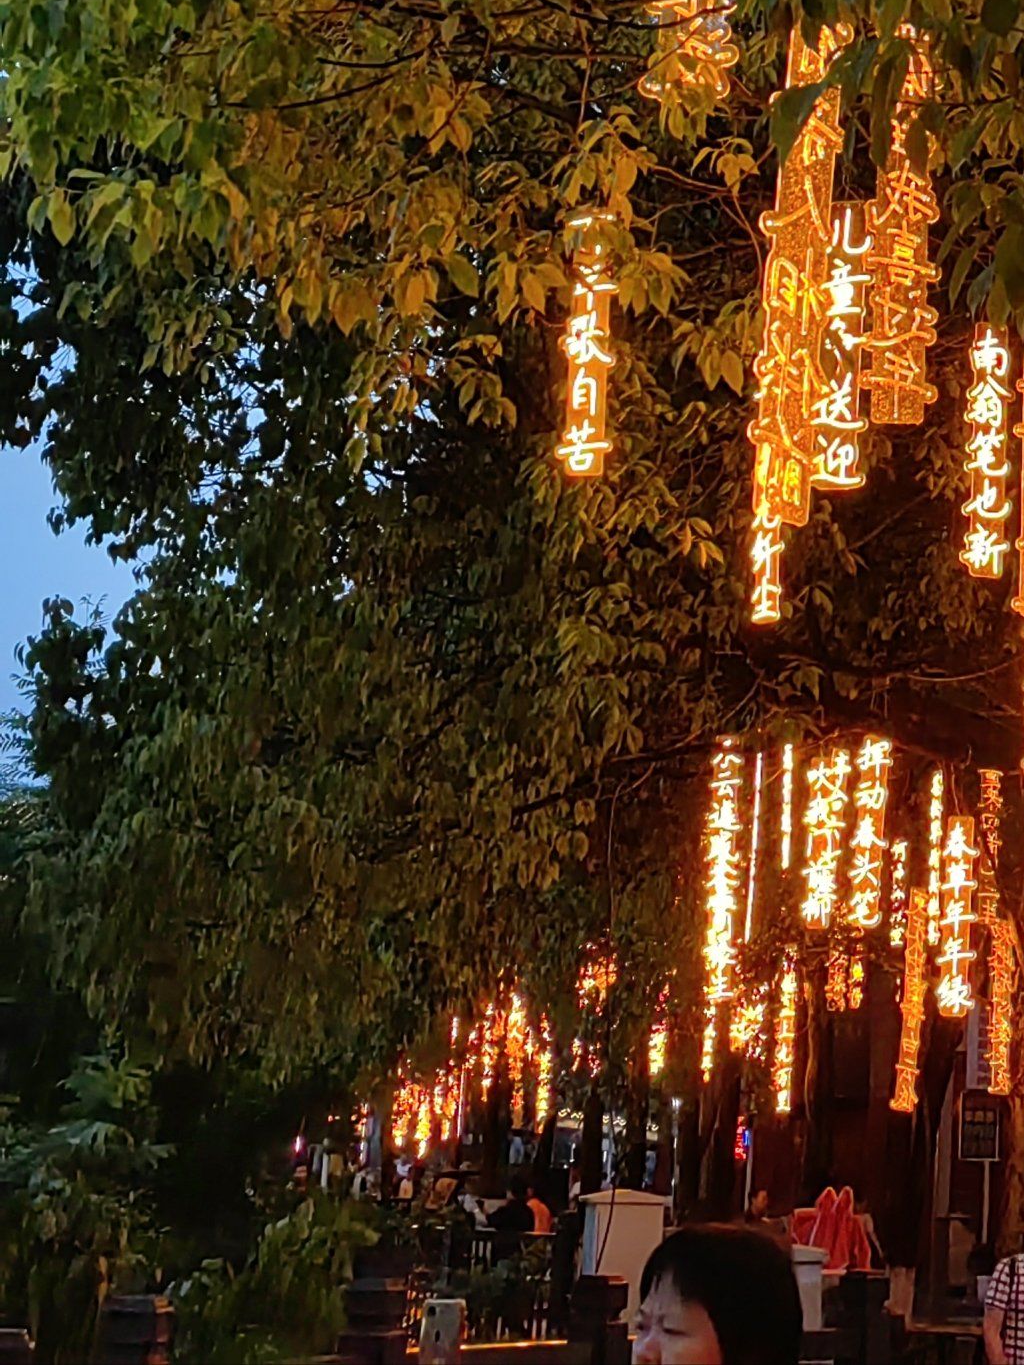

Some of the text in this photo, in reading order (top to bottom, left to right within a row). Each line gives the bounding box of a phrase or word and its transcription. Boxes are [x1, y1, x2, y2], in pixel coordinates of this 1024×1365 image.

[962, 330, 1011, 577] 南翁笔也新
[938, 823, 977, 1015] 春草年年绿
